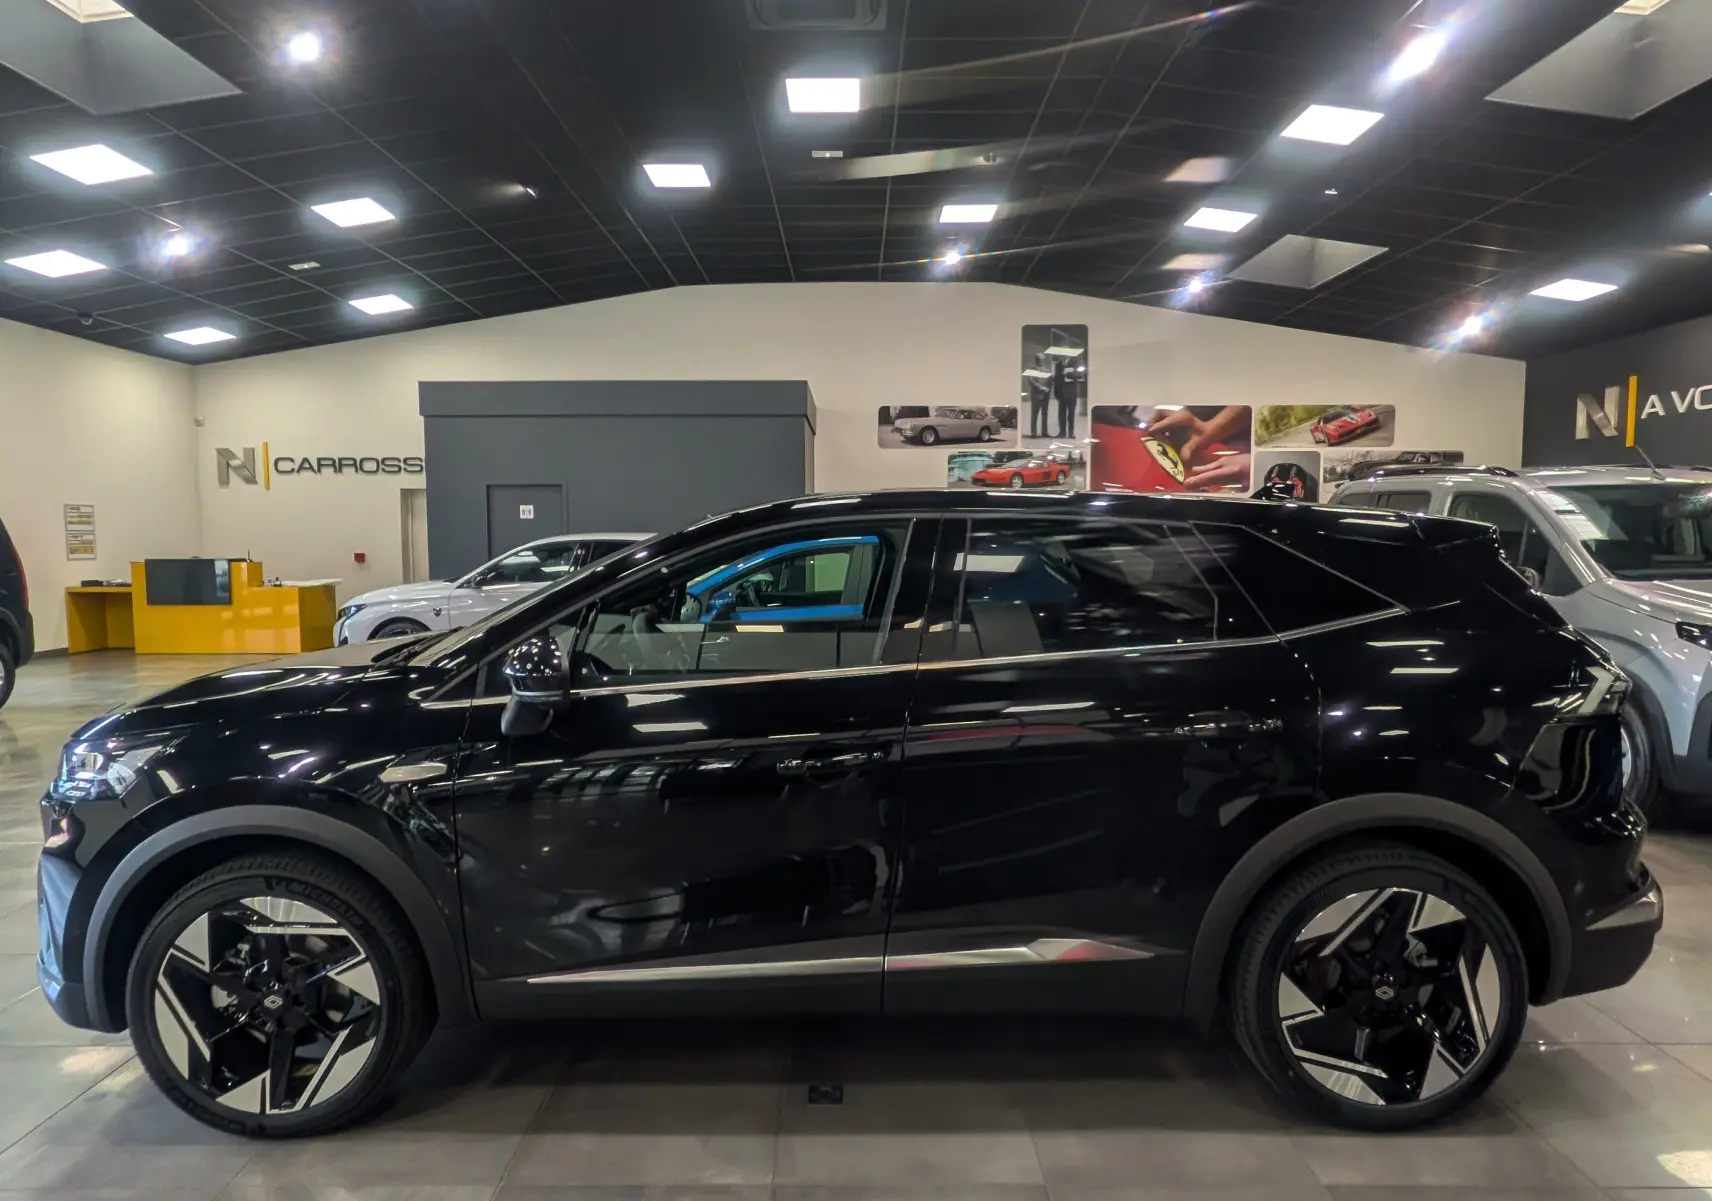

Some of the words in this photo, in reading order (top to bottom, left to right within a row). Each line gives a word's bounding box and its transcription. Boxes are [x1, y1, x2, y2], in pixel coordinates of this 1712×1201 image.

[1575, 386, 1620, 440] N
[216, 447, 259, 487] N
[273, 456, 424, 475] CARROSS
